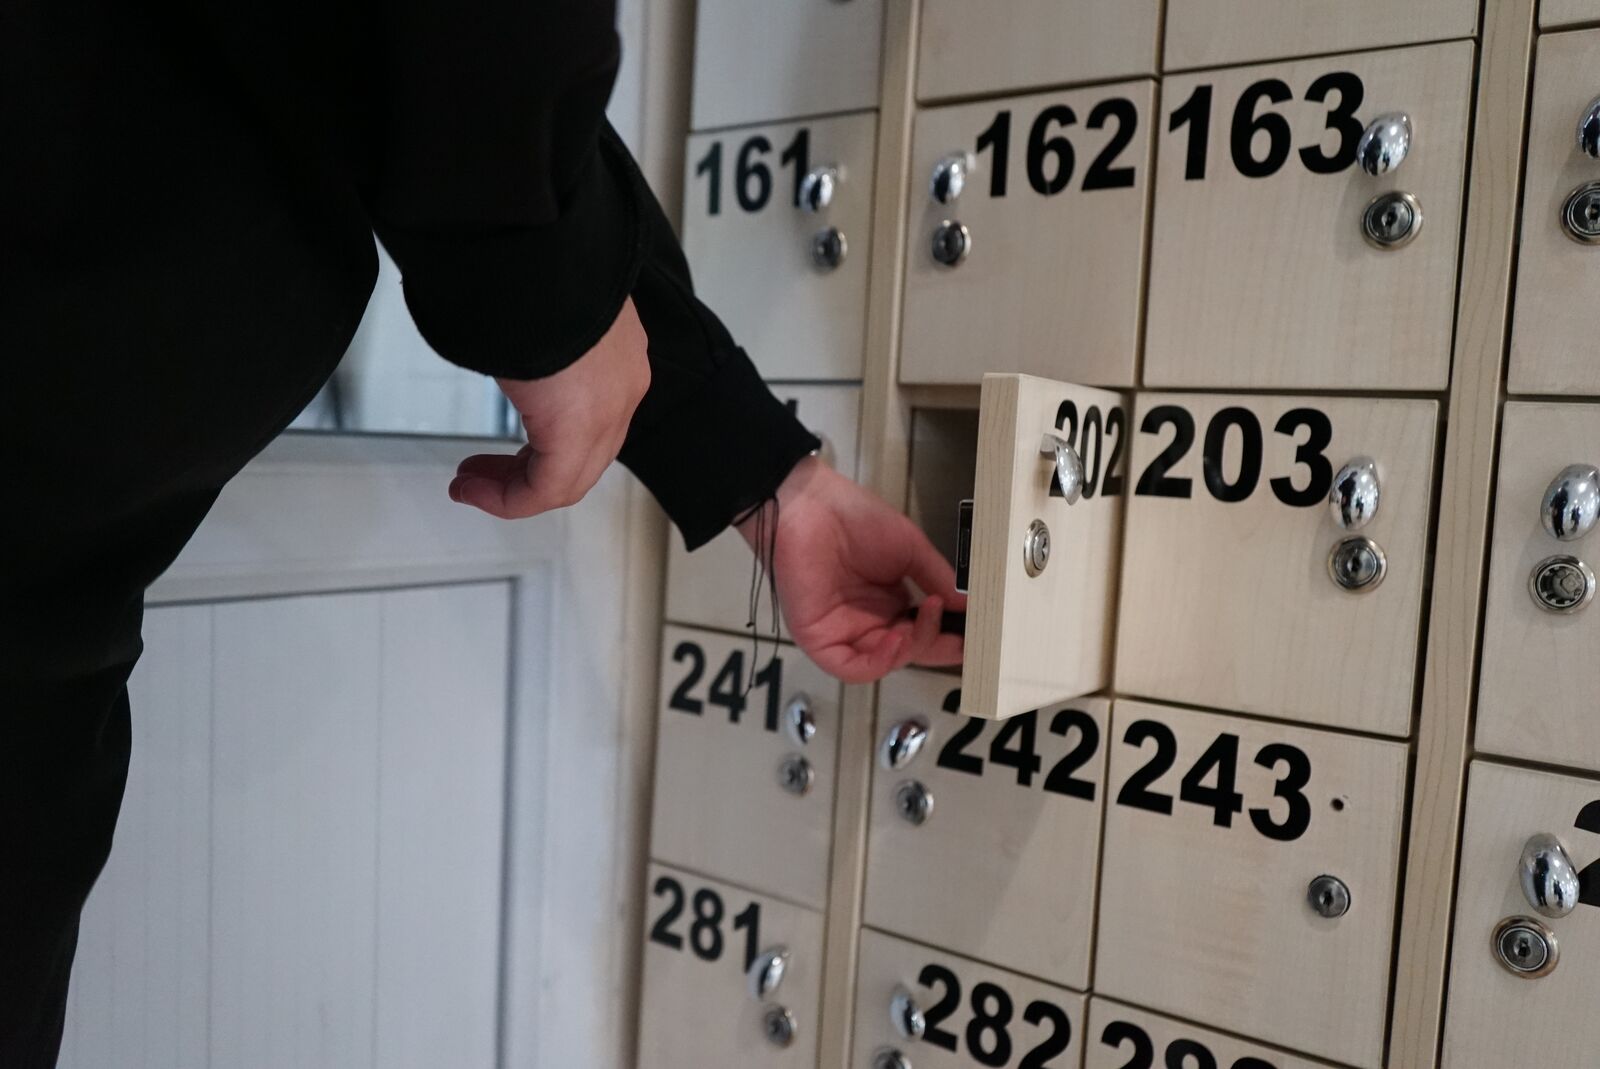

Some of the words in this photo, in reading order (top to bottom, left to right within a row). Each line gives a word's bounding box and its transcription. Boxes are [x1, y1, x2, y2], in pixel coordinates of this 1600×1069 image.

[696, 127, 811, 216] 161
[976, 97, 1138, 198] 162
[1168, 71, 1369, 181] 163
[1048, 400, 1126, 500] 202
[1134, 405, 1334, 508] 203
[669, 641, 783, 732] 241
[936, 688, 1100, 802] 242
[1116, 719, 1312, 842] 243
[650, 876, 760, 975] 281
[917, 963, 1072, 1069] 282
